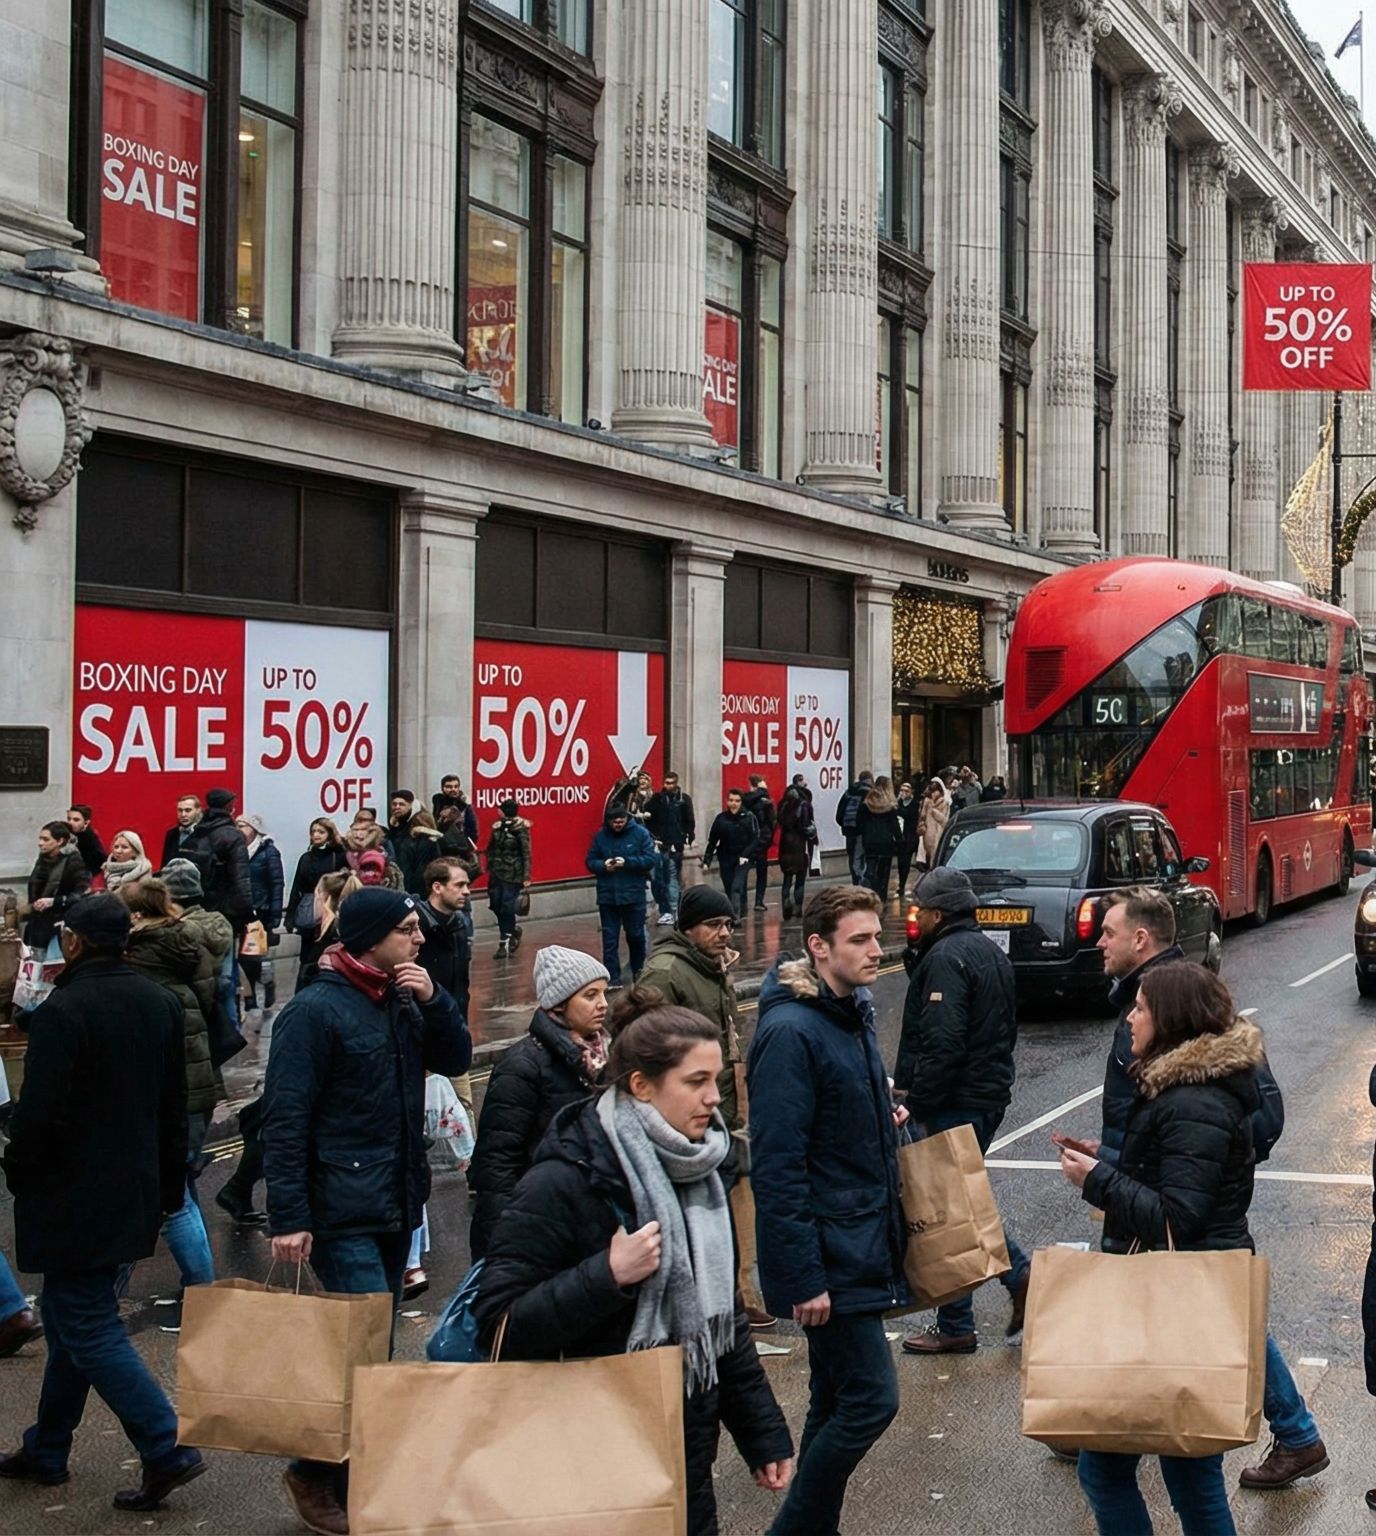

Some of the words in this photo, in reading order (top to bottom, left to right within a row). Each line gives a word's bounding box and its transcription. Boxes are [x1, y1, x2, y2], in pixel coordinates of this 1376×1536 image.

[104, 132, 165, 169] BOXING
[168, 155, 198, 180] DAY
[103, 159, 196, 226] SALE
[1280, 287, 1305, 301] UP
[1309, 287, 1335, 301] TO
[1264, 308, 1352, 342] 50%
[1280, 347, 1334, 368] OFF
[702, 369, 736, 406] ALE
[80, 662, 176, 693] BOXING
[183, 668, 228, 695] DAY
[263, 667, 287, 689] UP
[292, 669, 317, 691] TO
[478, 664, 499, 686] UP
[502, 665, 522, 687] TO
[721, 694, 760, 714] BOXING
[761, 696, 780, 715] DAY
[794, 695, 806, 710] UP
[808, 695, 819, 711] TO
[78, 704, 228, 774] SALE
[261, 700, 373, 770] 50%
[476, 696, 589, 778] 50%
[721, 720, 780, 765] SALE
[794, 716, 842, 761] 50%
[321, 778, 372, 813] OFF
[515, 785, 590, 806] REDUCTIONS
[819, 767, 843, 790] OFF
